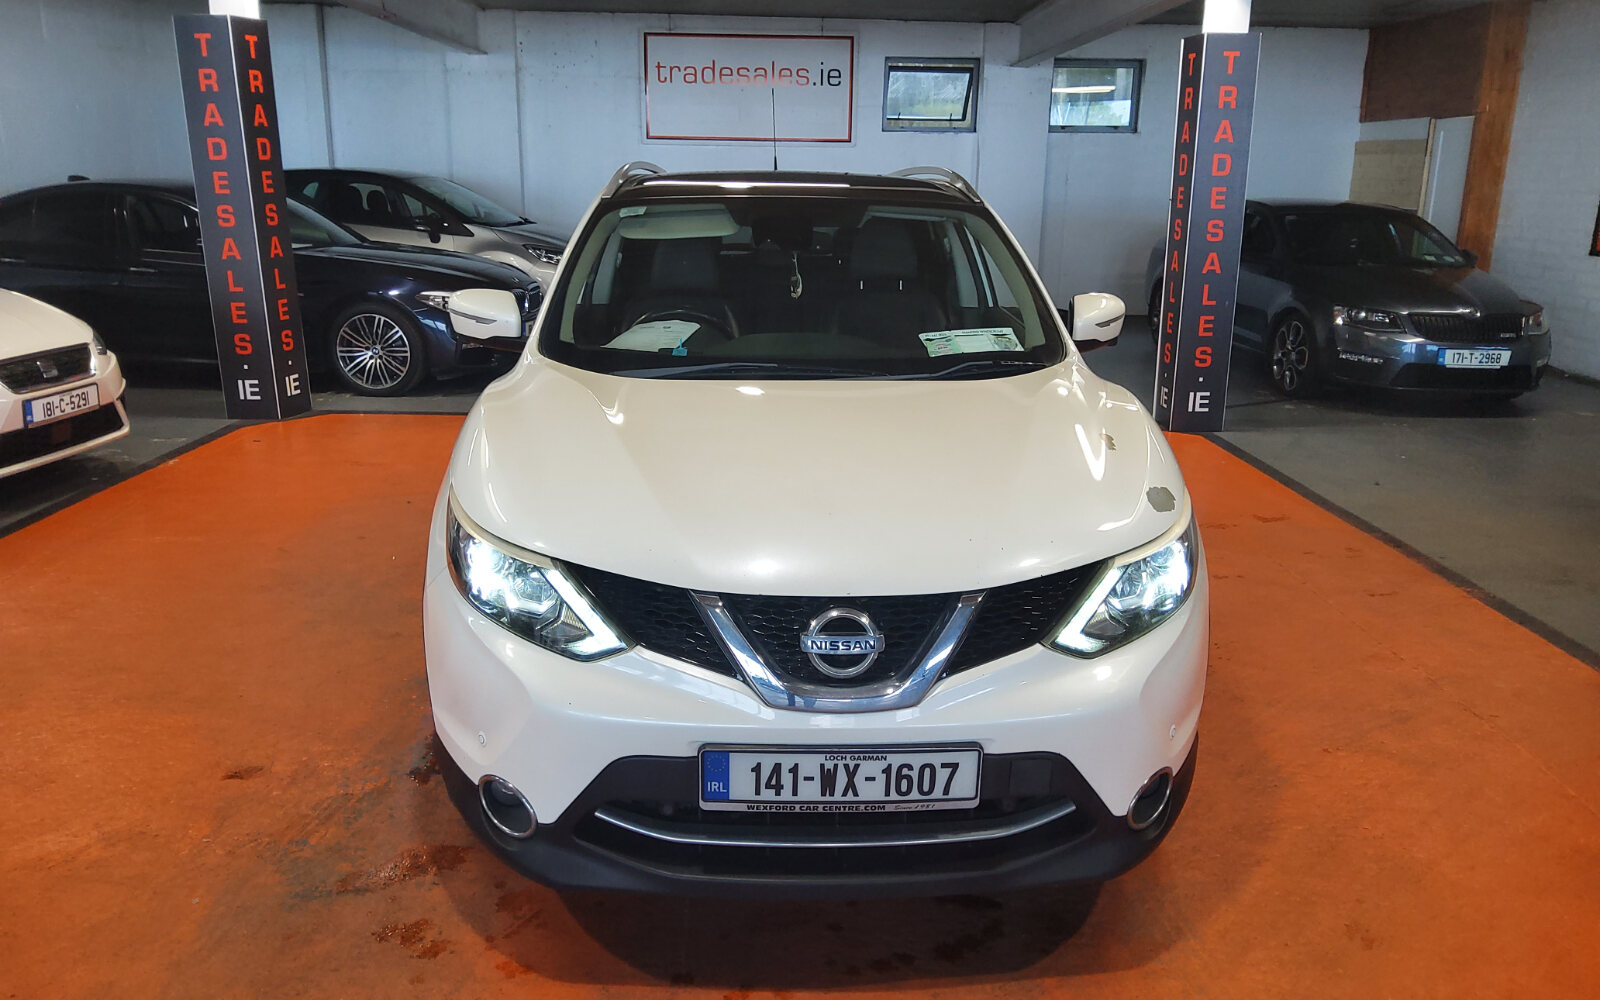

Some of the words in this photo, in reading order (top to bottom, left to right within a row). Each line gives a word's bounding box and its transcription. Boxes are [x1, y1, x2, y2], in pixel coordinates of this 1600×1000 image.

[655, 59, 842, 87] tradesales.ie
[1452, 352, 1502, 364] 171-T-2968
[42, 391, 90, 418] 181-C-5291
[810, 639, 876, 651] NISSAN
[750, 762, 960, 797] 141-WX-1607
[707, 782, 727, 793] IRL
[746, 804, 796, 812] WEXFORD
[799, 804, 819, 812] CAR
[822, 803, 886, 812] CENTRE.COM
